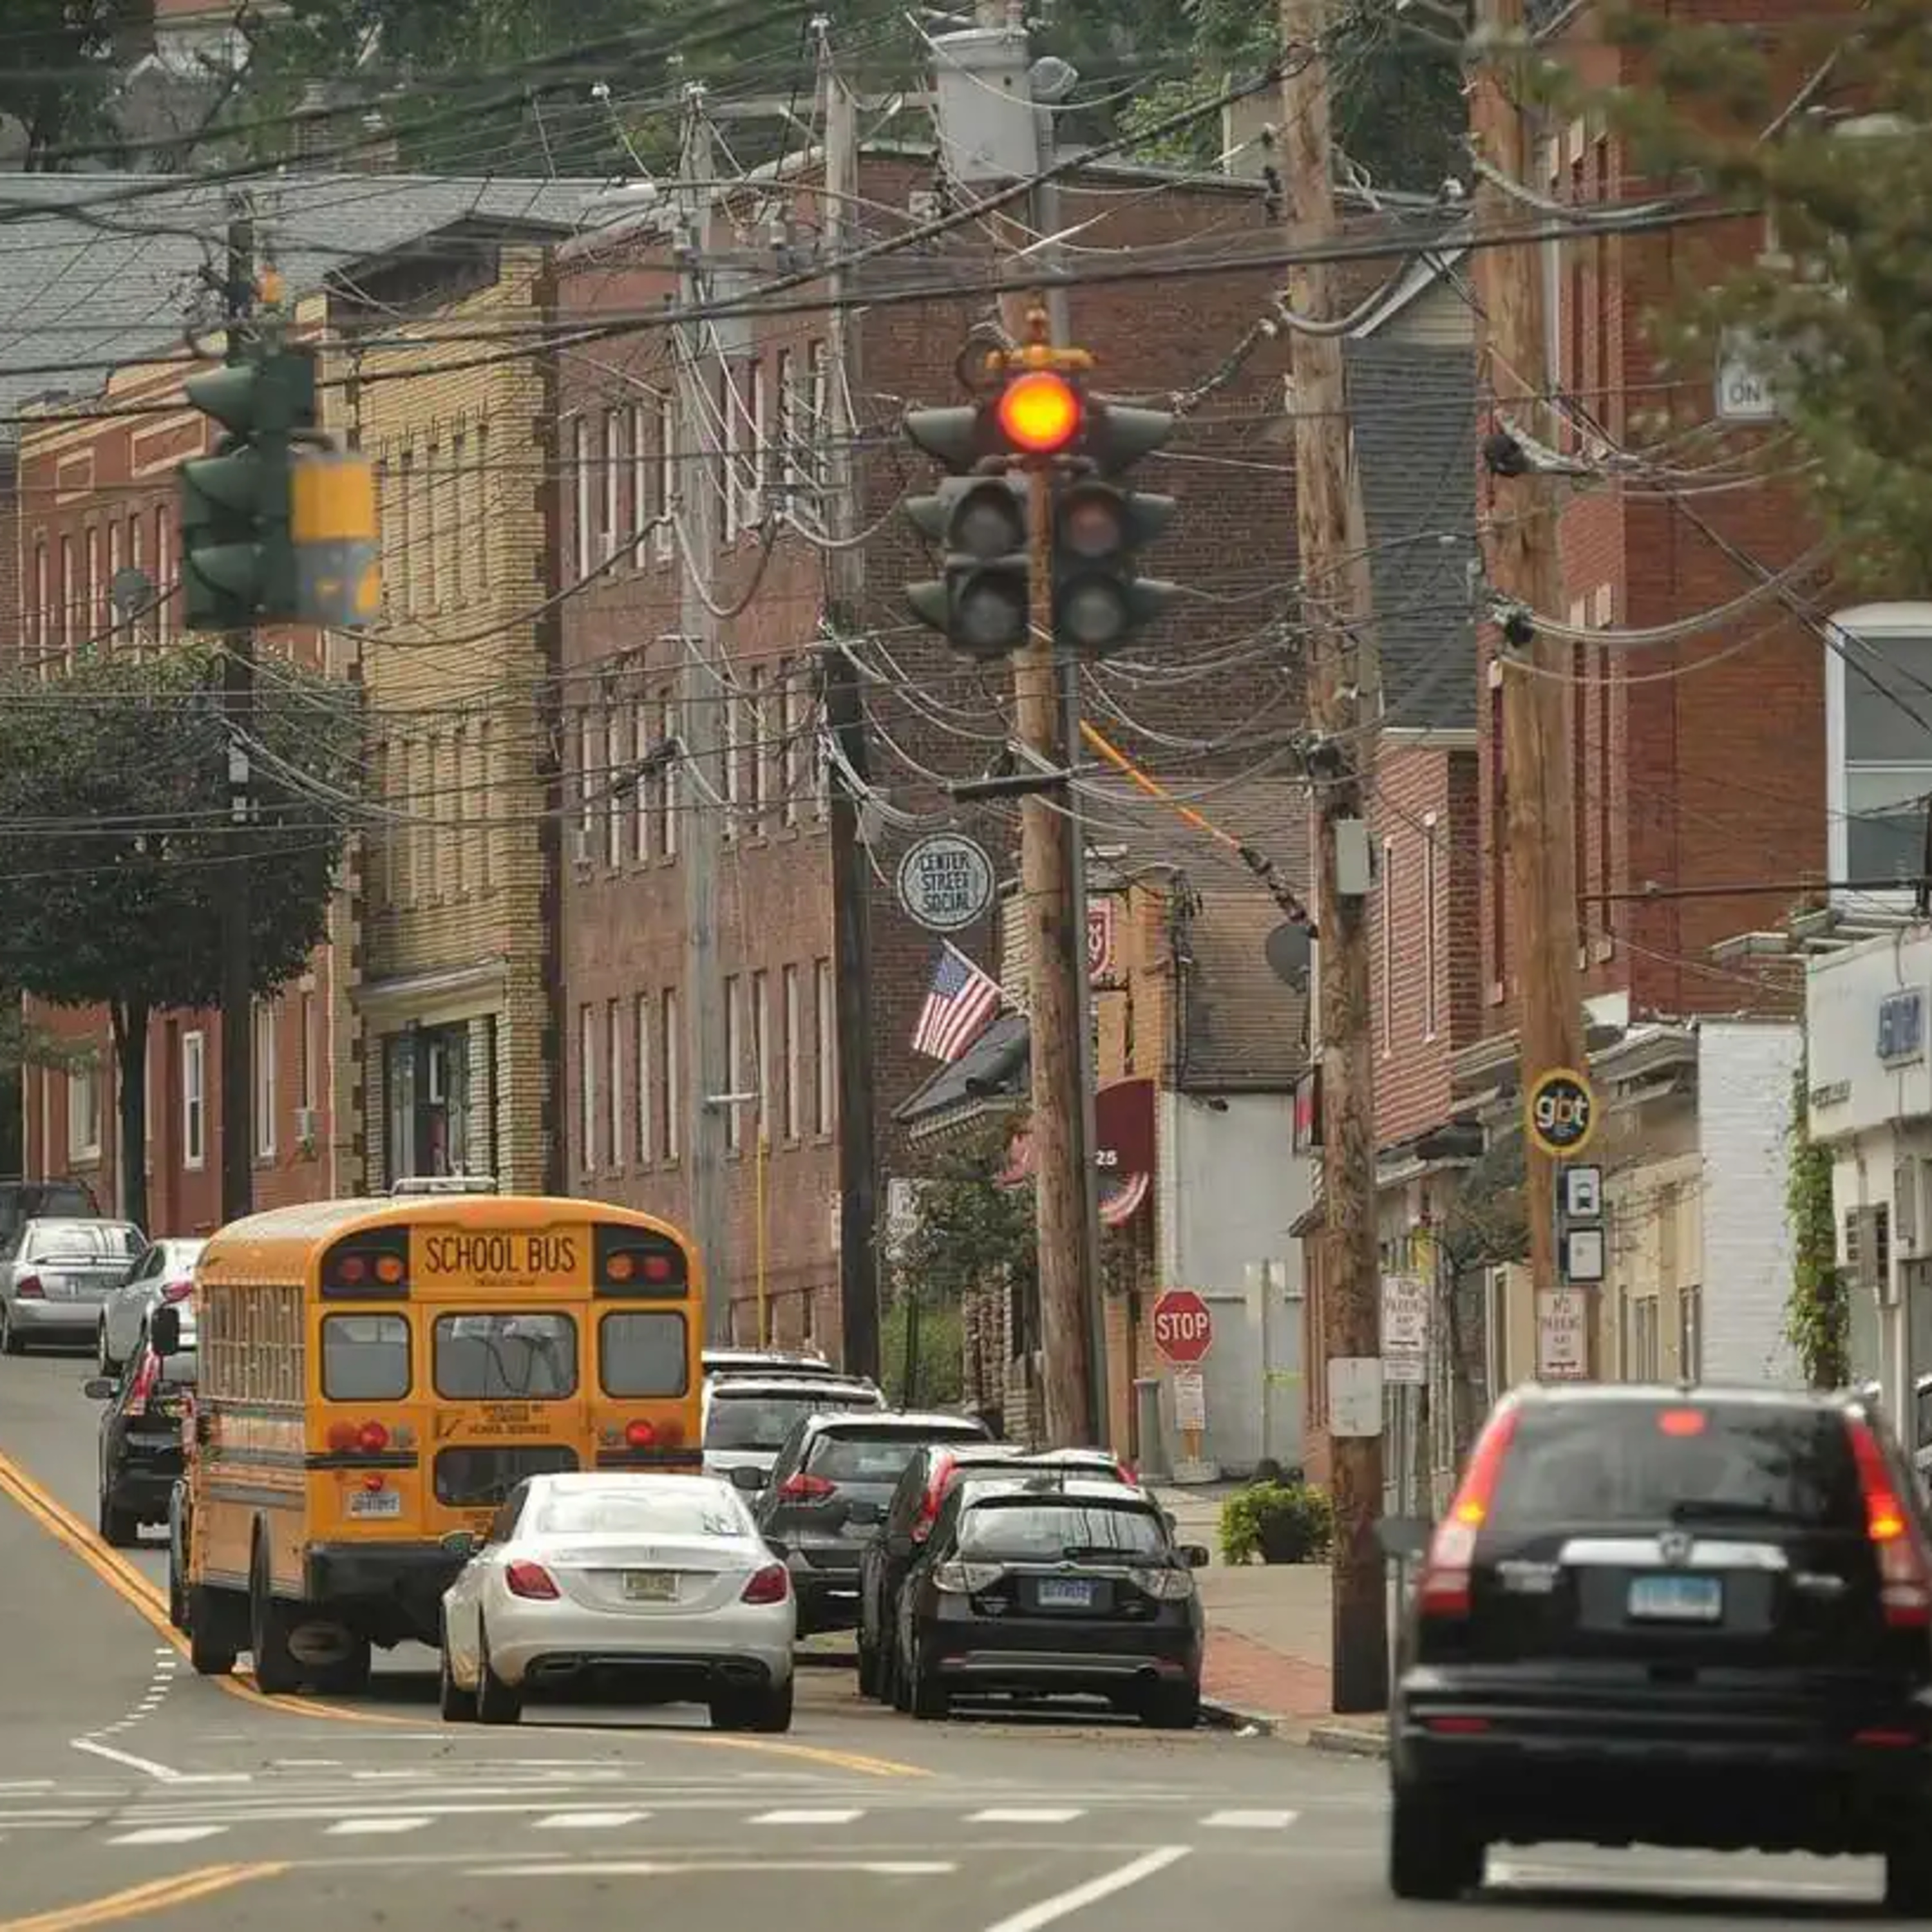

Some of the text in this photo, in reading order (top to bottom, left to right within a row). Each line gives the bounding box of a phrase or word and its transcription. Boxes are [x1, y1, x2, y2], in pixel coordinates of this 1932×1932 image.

[920, 851, 971, 871] CENTER
[922, 872, 969, 891] STREET
[923, 893, 971, 911] SOCIAL
[1096, 1150, 1117, 1165] 25
[425, 1236, 575, 1273] SCHOOL BUS
[1157, 1312, 1208, 1340] STOP
